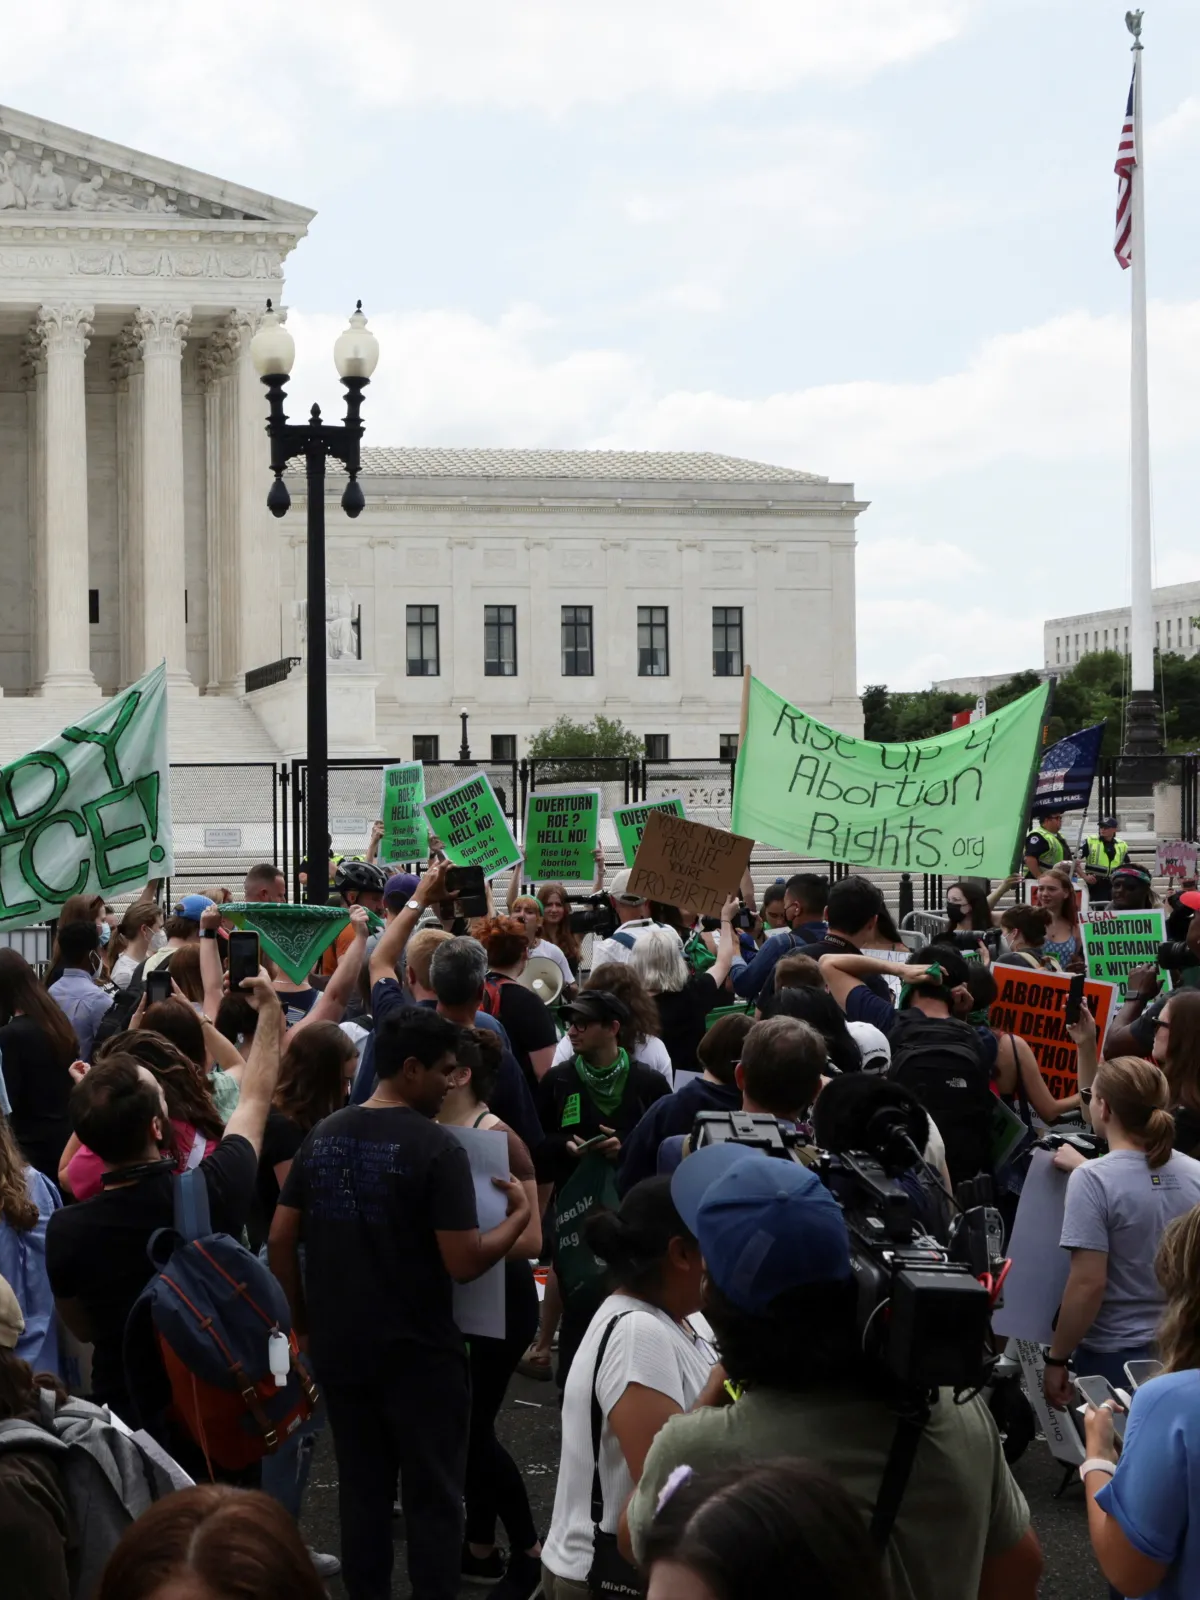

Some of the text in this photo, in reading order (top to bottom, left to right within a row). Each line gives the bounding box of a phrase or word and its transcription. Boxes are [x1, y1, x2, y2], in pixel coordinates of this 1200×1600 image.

[15, 251, 56, 268] LAW
[773, 703, 857, 758] Rise
[965, 718, 999, 763] 4
[389, 768, 420, 786] OVERTURN
[788, 754, 983, 808] Abortion
[398, 789, 411, 802] ROE
[430, 780, 485, 819] OVERTURN
[535, 796, 593, 812] OVERTURN
[391, 804, 421, 821] HELL NO
[449, 802, 479, 829] ROE ?
[547, 813, 580, 828] ROE ?
[448, 813, 495, 848] HELL NO!
[537, 829, 587, 843] HELL NO!
[392, 838, 417, 847] Abortion
[460, 835, 496, 858] Rise Up 4
[704, 828, 741, 851] NOT
[541, 848, 558, 857] Rise
[561, 848, 572, 858] Up
[483, 855, 509, 877] hts.org
[541, 859, 577, 867] Abortion
[538, 869, 581, 879] Rights.org
[1079, 911, 1117, 924] LEGAL
[1092, 919, 1153, 935] ABORTION
[824, 934, 846, 947] Canon
[1087, 941, 1105, 956] ON
[1095, 963, 1103, 976] &
[1002, 980, 1100, 1018] ABORTN
[990, 1007, 1017, 1033] ON
